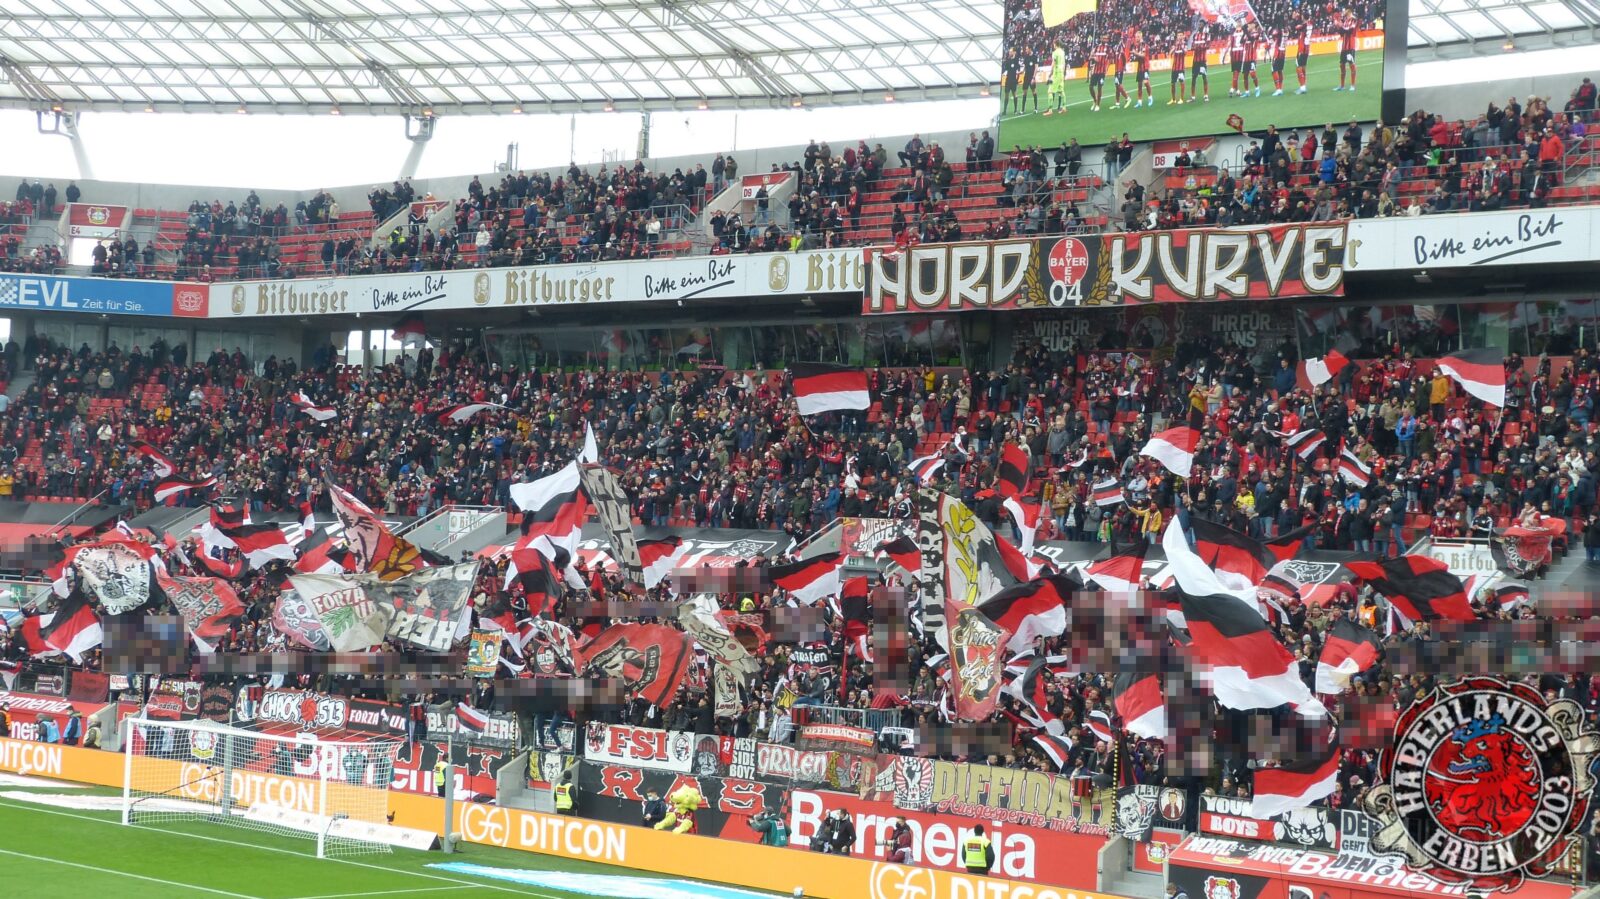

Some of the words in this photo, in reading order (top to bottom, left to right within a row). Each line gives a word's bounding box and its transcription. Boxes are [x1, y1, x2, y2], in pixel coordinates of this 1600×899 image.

[1154, 156, 1166, 167] D8
[743, 187, 753, 198] D9
[71, 226, 81, 235] E4
[1414, 236, 1466, 265] Bitte
[1472, 230, 1513, 251] ein
[1518, 213, 1563, 242] Bit
[805, 252, 865, 293] Bitb
[1050, 256, 1087, 267] BAYER
[1065, 240, 1073, 284] BAYER
[504, 269, 614, 304] Bitburger
[645, 275, 677, 299] Bitte
[679, 274, 706, 288] ein
[708, 259, 736, 283] Bit
[19, 279, 78, 308] EVL
[256, 284, 349, 315] Bitburger
[373, 286, 401, 311] Bitte
[402, 285, 424, 299] ein
[424, 276, 447, 297] Bit
[1050, 280, 1082, 306] 04
[82, 298, 103, 310] Zeit
[106, 300, 121, 310] für
[124, 300, 144, 311] Sie.
[261, 692, 302, 723] CHAOS
[317, 699, 347, 727] 513
[350, 710, 379, 726] FORZA
[608, 725, 669, 761] FSI
[733, 737, 756, 752] WEST
[732, 751, 755, 767] SIDE
[729, 765, 755, 780] BOYZ
[232, 772, 315, 811] DITCON
[1138, 786, 1159, 797] LEV
[1203, 796, 1254, 816] YOUN
[1210, 815, 1259, 837] BOYS
[520, 814, 626, 861] DITCON
[1342, 839, 1366, 852] GEHT
[1331, 853, 1377, 873] DEN
